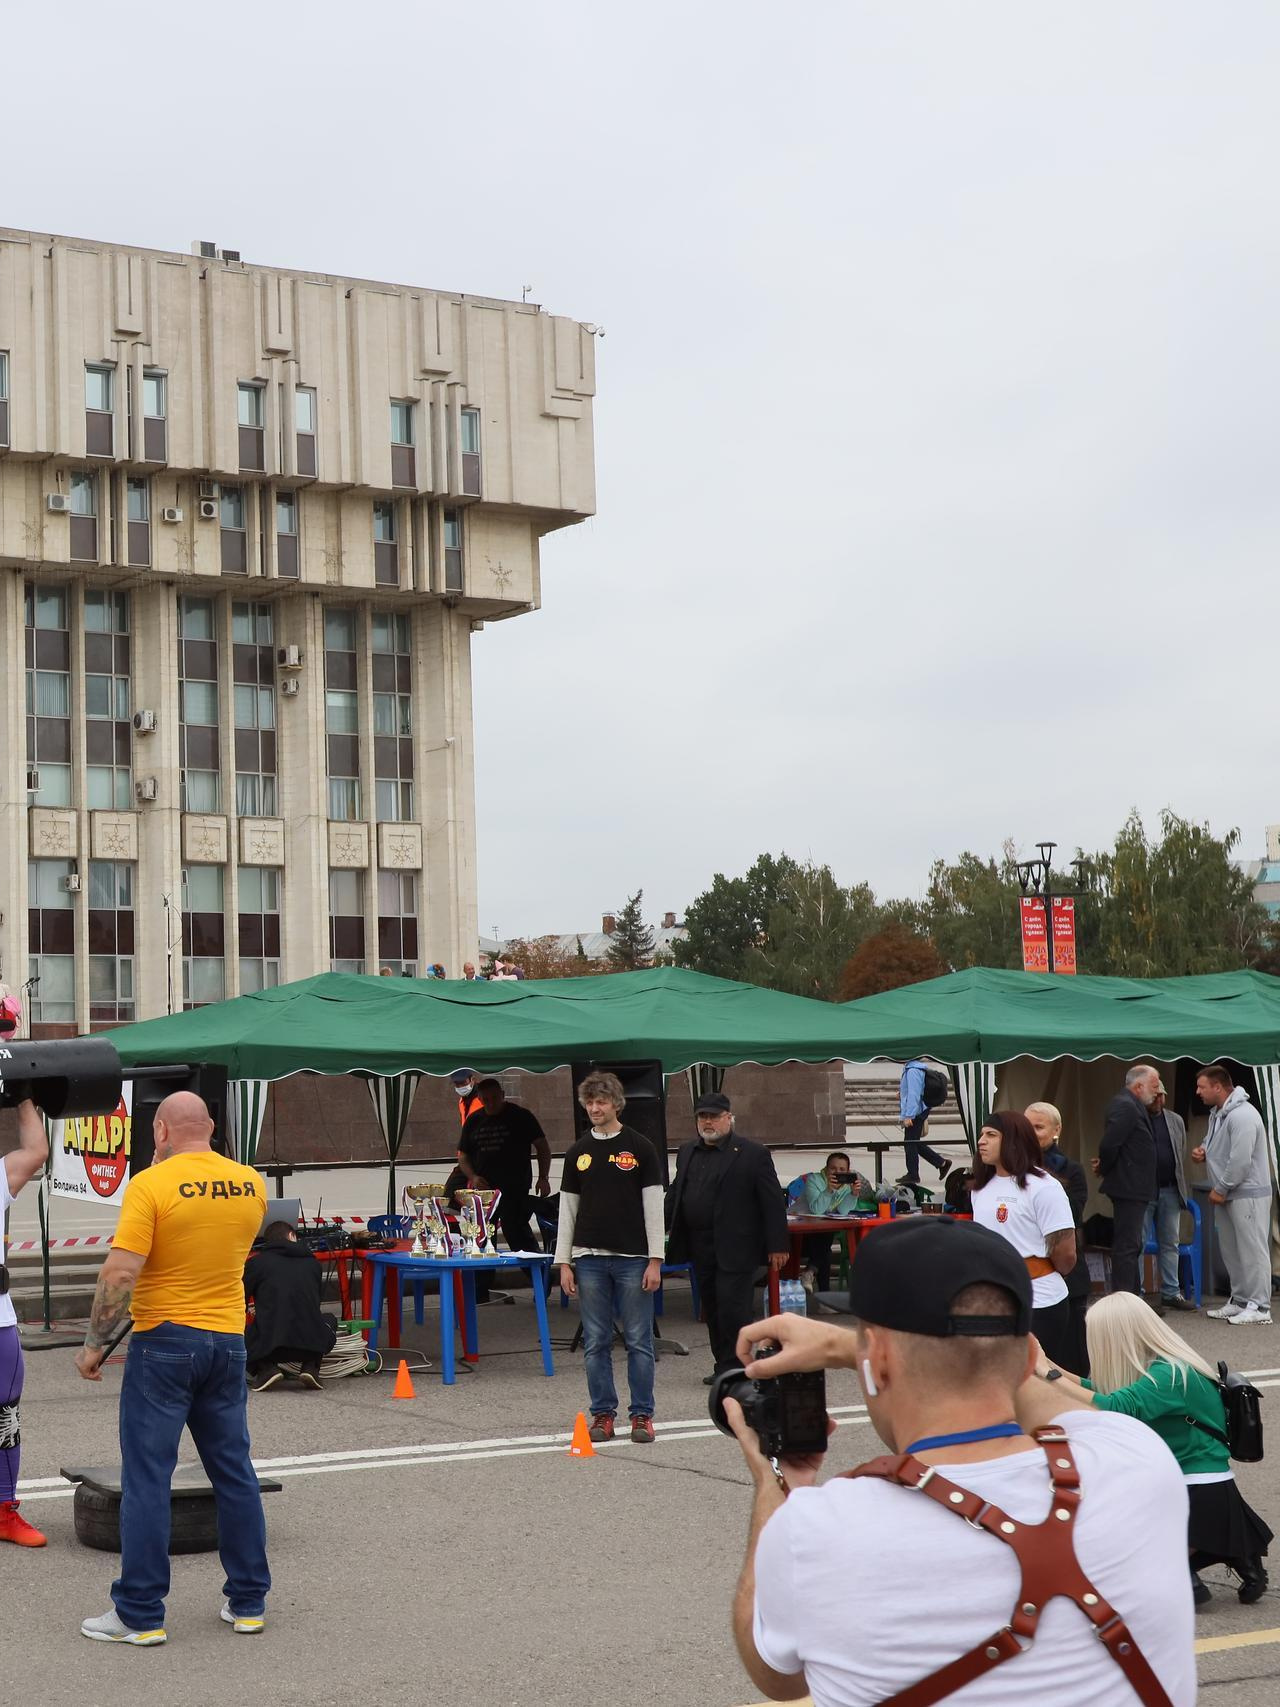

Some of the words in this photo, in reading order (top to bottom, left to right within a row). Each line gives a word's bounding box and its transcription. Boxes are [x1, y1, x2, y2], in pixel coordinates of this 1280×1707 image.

[91, 1164, 117, 1178] ФИТНЕС
[53, 1178, 79, 1193] Болдина
[79, 1182, 87, 1194] 94
[178, 1180, 256, 1200] СУДЬЯ
